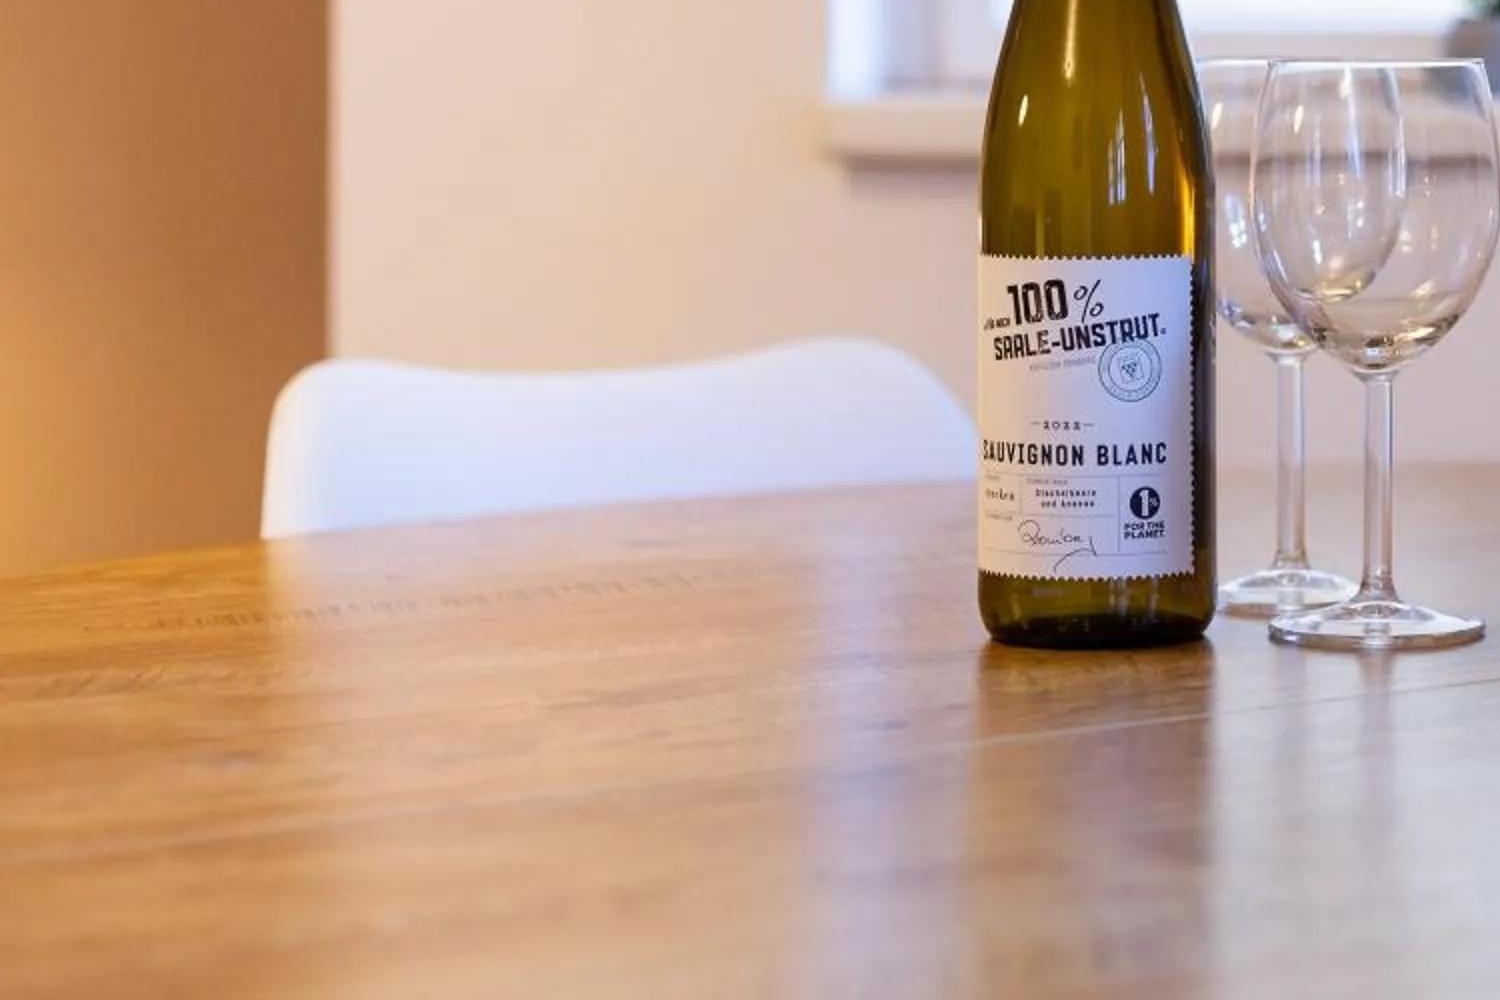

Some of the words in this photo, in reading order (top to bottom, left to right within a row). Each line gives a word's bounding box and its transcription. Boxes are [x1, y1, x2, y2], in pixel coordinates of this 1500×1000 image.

[983, 439, 1084, 467] SAUVIGNON
[1096, 441, 1167, 467] BLANC
[1123, 522, 1144, 531] FOR
[1147, 520, 1165, 530] THE
